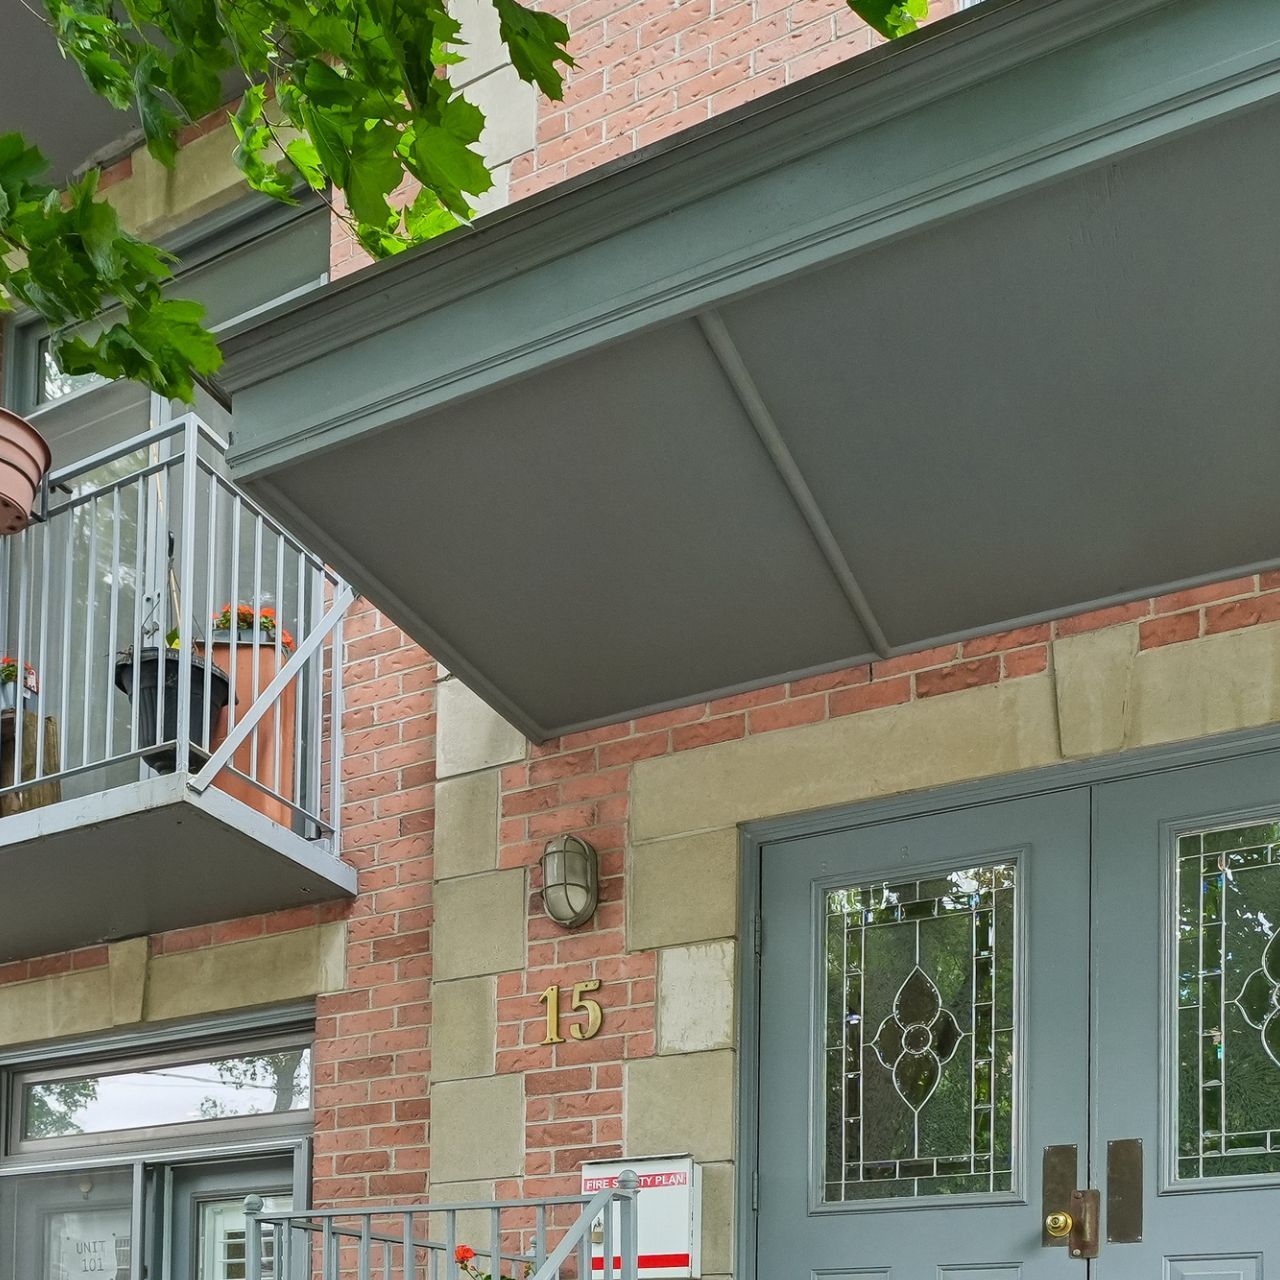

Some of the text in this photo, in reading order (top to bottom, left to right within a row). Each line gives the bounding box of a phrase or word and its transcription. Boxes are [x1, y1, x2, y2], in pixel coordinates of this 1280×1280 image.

[538, 979, 603, 1045] 15
[586, 1174, 685, 1189] FIRE STY PLAN
[76, 1240, 106, 1254] UNIT
[82, 1258, 104, 1272] 101
